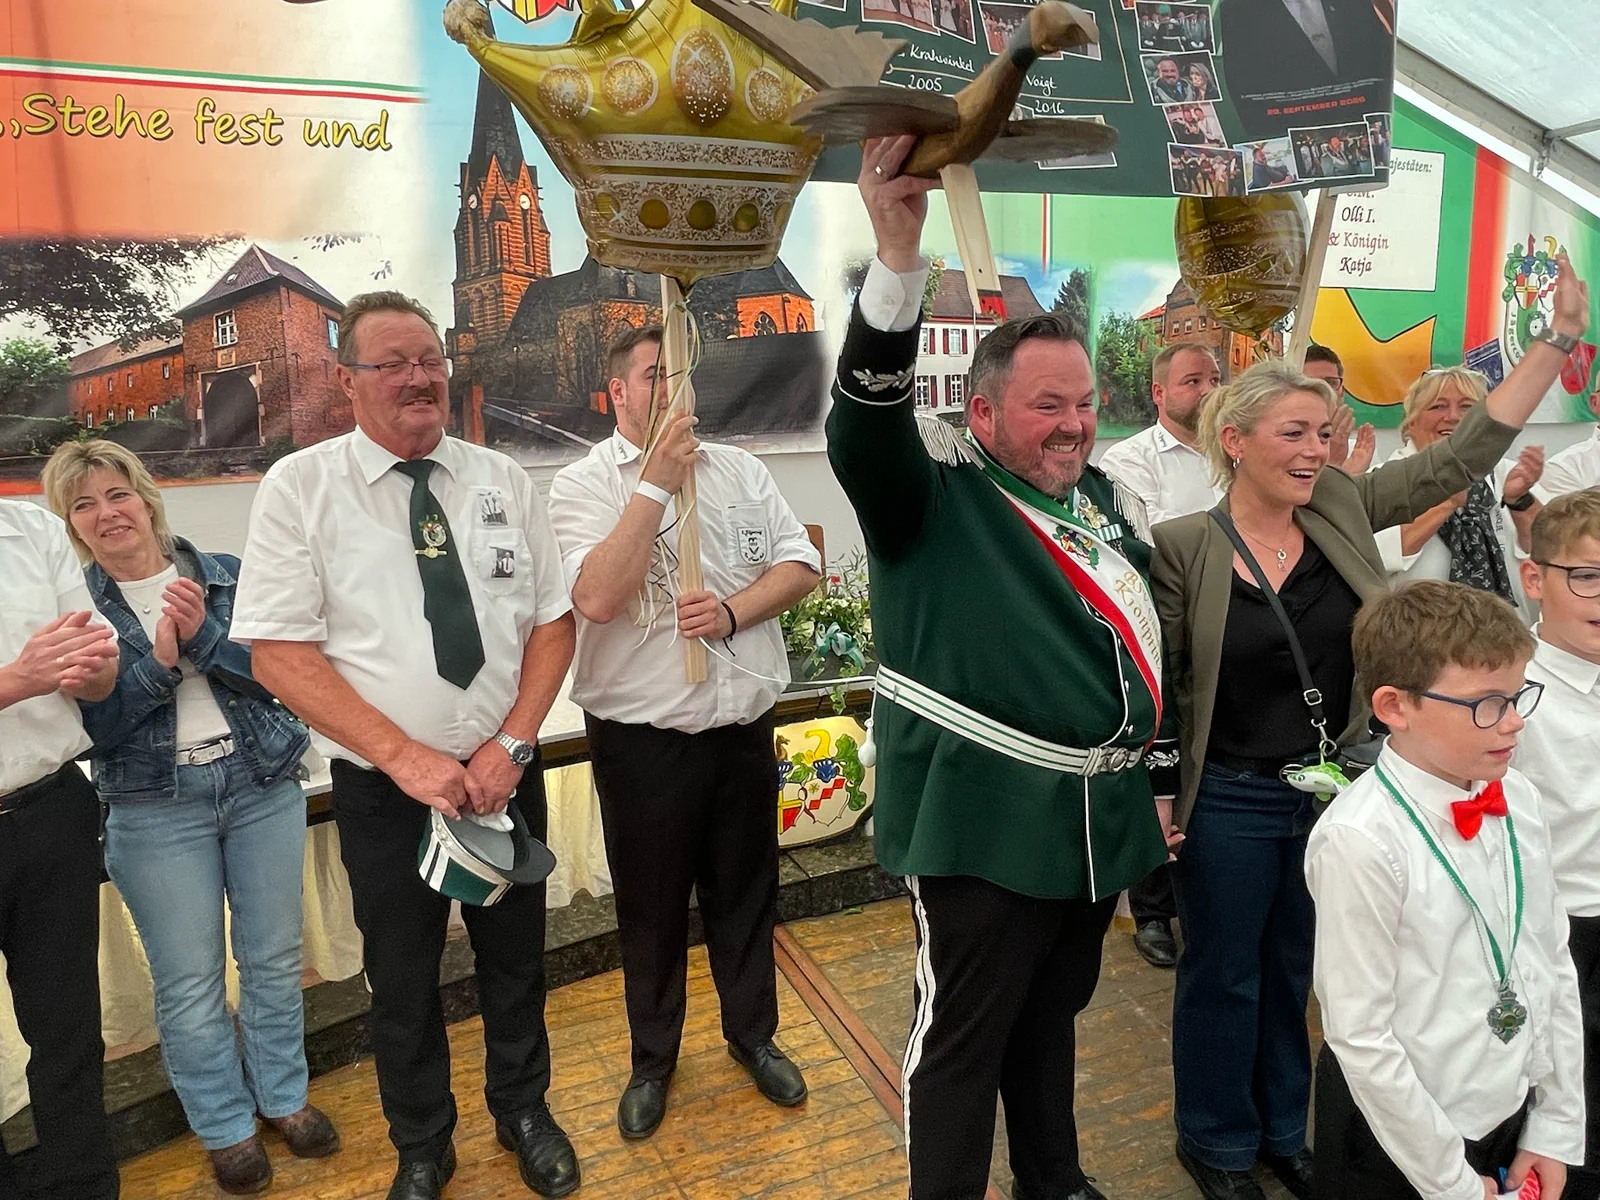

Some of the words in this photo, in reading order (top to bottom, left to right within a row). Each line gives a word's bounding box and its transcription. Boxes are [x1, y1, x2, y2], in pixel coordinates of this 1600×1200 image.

[907, 74, 943, 92] 2005
[1025, 75, 1057, 96] Voigt
[1034, 99, 1065, 114] 2016
[1283, 100, 1338, 114] SEPTEMBER
[194, 96, 285, 146] fest
[303, 109, 393, 151] und
[1389, 158, 1432, 175] ajestäten:
[1341, 205, 1364, 222] Olli
[1365, 208, 1376, 223] I.
[1327, 232, 1340, 247] &
[1343, 231, 1389, 255] Königin
[1338, 256, 1372, 277] Katja
[1508, 312, 1520, 359] Jägerco
